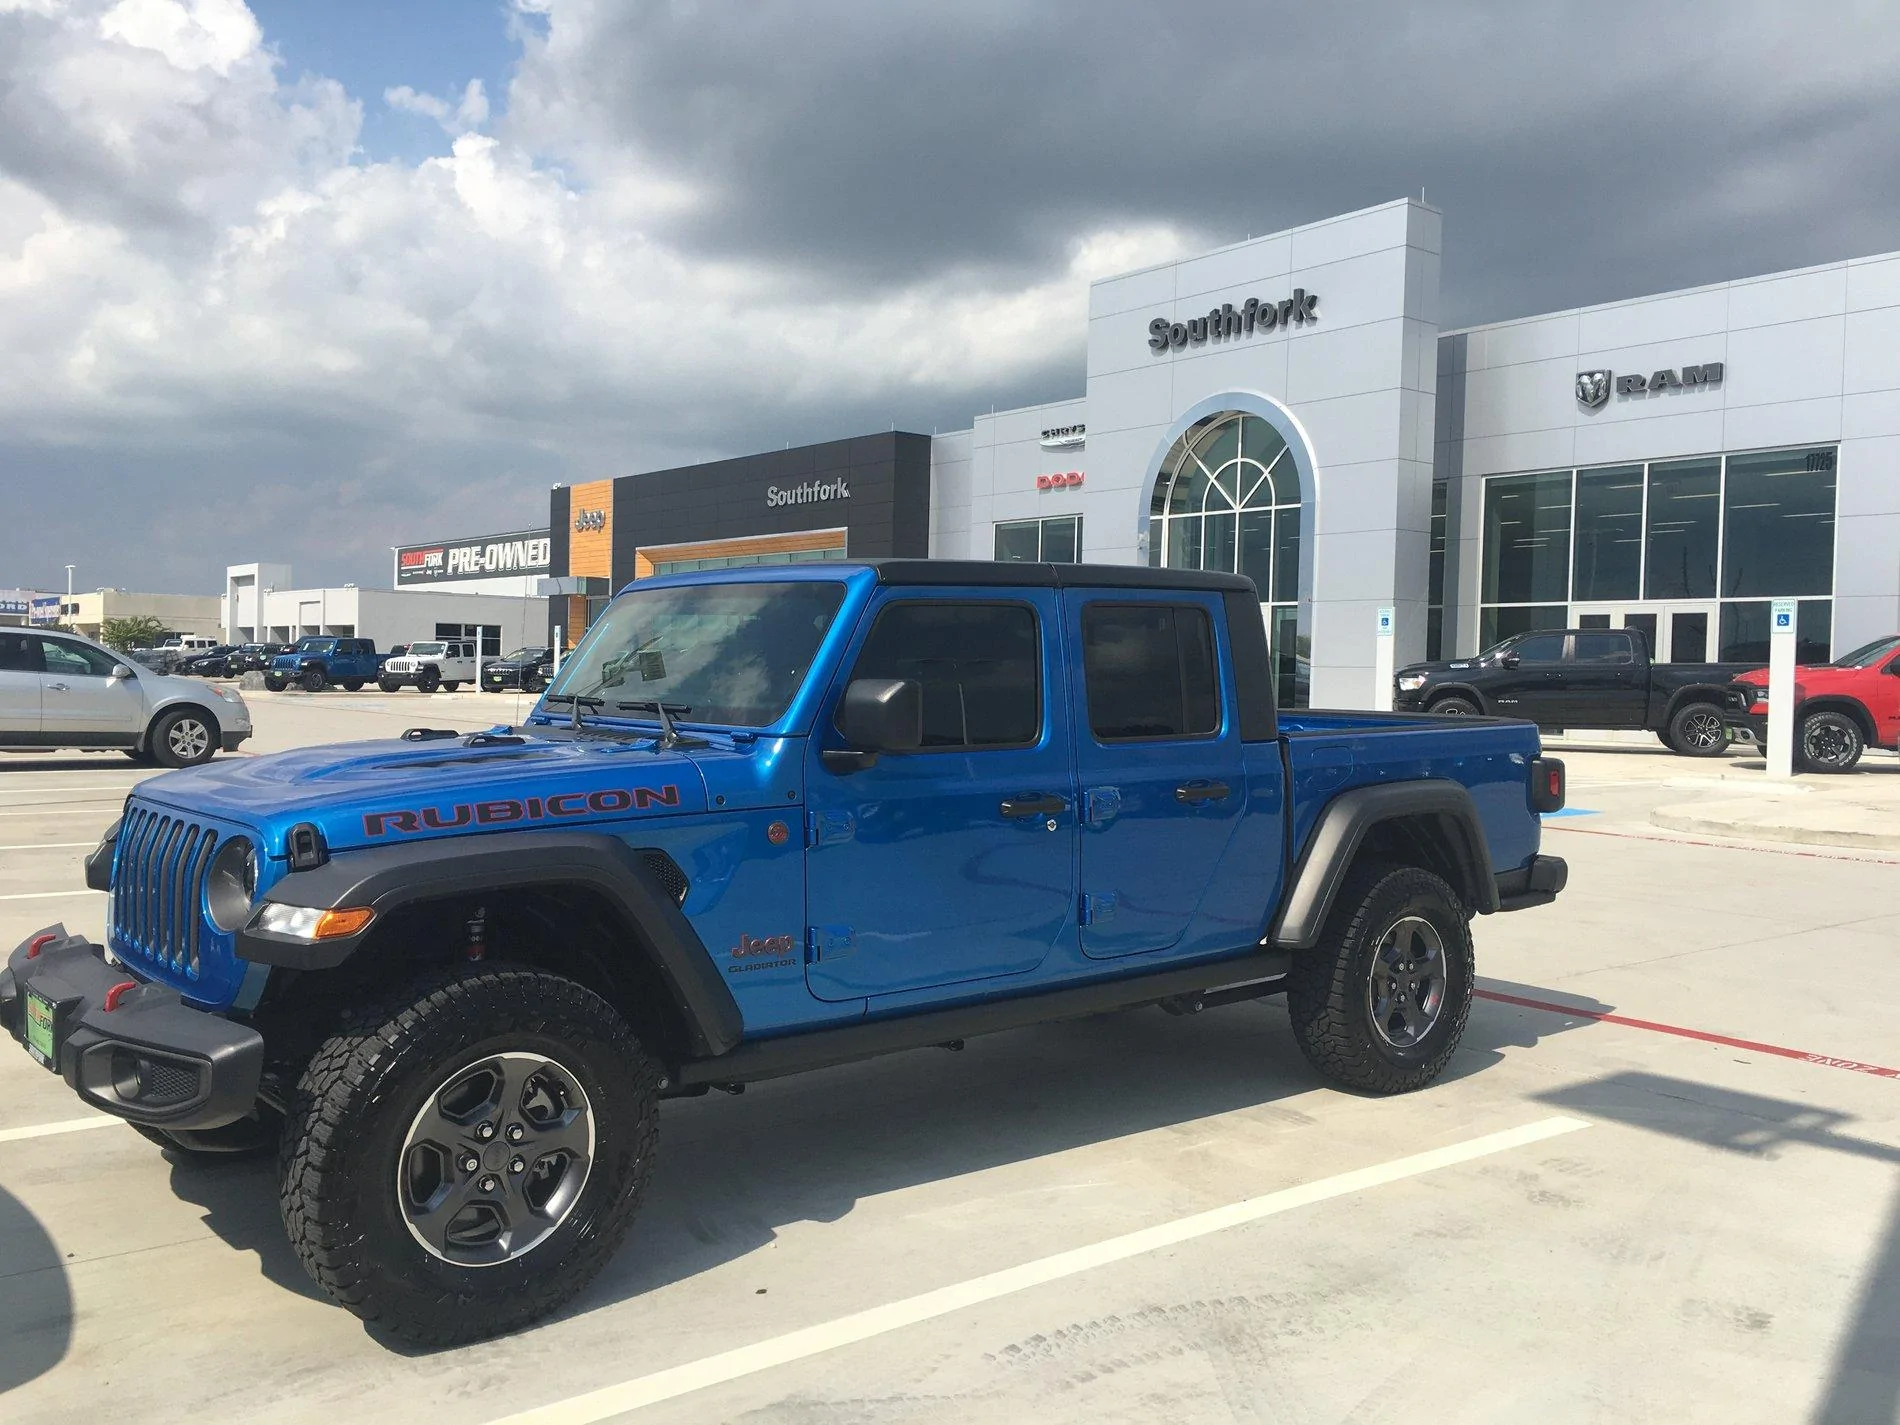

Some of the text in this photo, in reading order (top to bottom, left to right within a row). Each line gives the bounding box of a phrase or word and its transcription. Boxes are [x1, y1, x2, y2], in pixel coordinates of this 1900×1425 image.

[1148, 288, 1318, 349] Southfork
[1616, 362, 1723, 394] RAM
[767, 477, 850, 507] Southfork
[1036, 472, 1085, 489] DOD
[575, 508, 605, 533] Jeep
[447, 538, 550, 575] PRE-OWNED
[363, 784, 679, 837] RUBICON
[732, 933, 791, 958] Jeep
[728, 959, 797, 973] GLADIATOR
